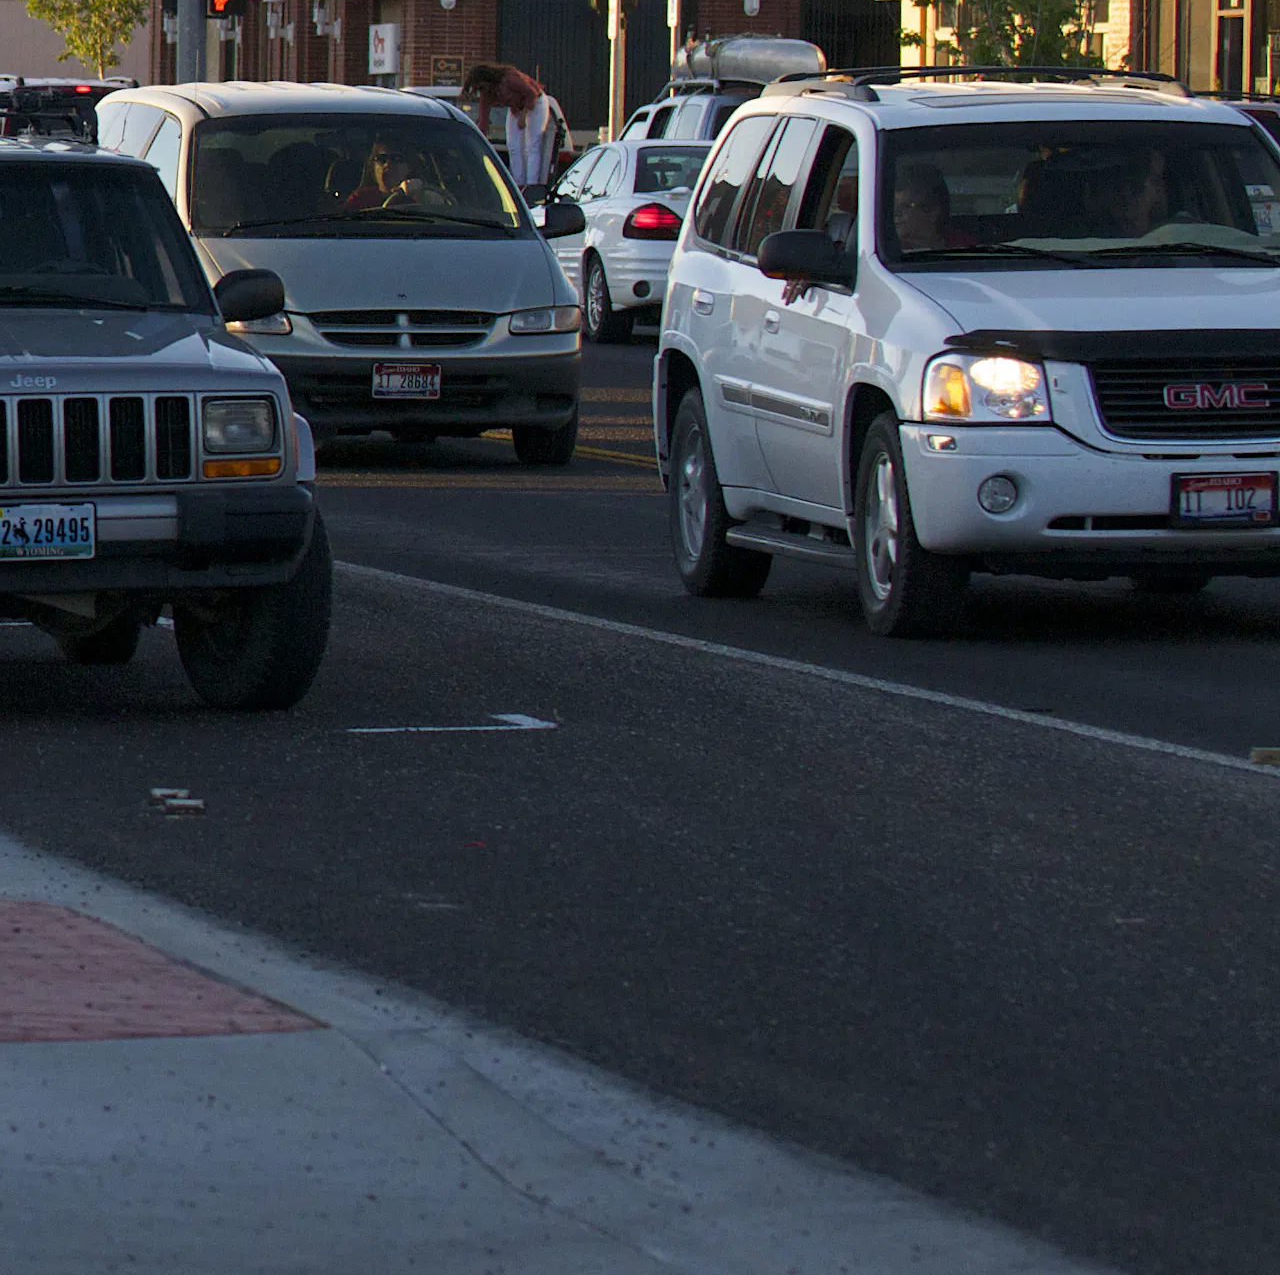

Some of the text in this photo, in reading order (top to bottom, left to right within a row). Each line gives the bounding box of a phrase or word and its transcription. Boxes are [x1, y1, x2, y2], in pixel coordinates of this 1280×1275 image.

[9, 374, 57, 390] Jeep
[400, 374, 436, 389] 28684
[1163, 383, 1271, 411] GMC
[1225, 487, 1257, 511] 102
[33, 517, 90, 544] 29495
[15, 545, 65, 557] WYOMING
